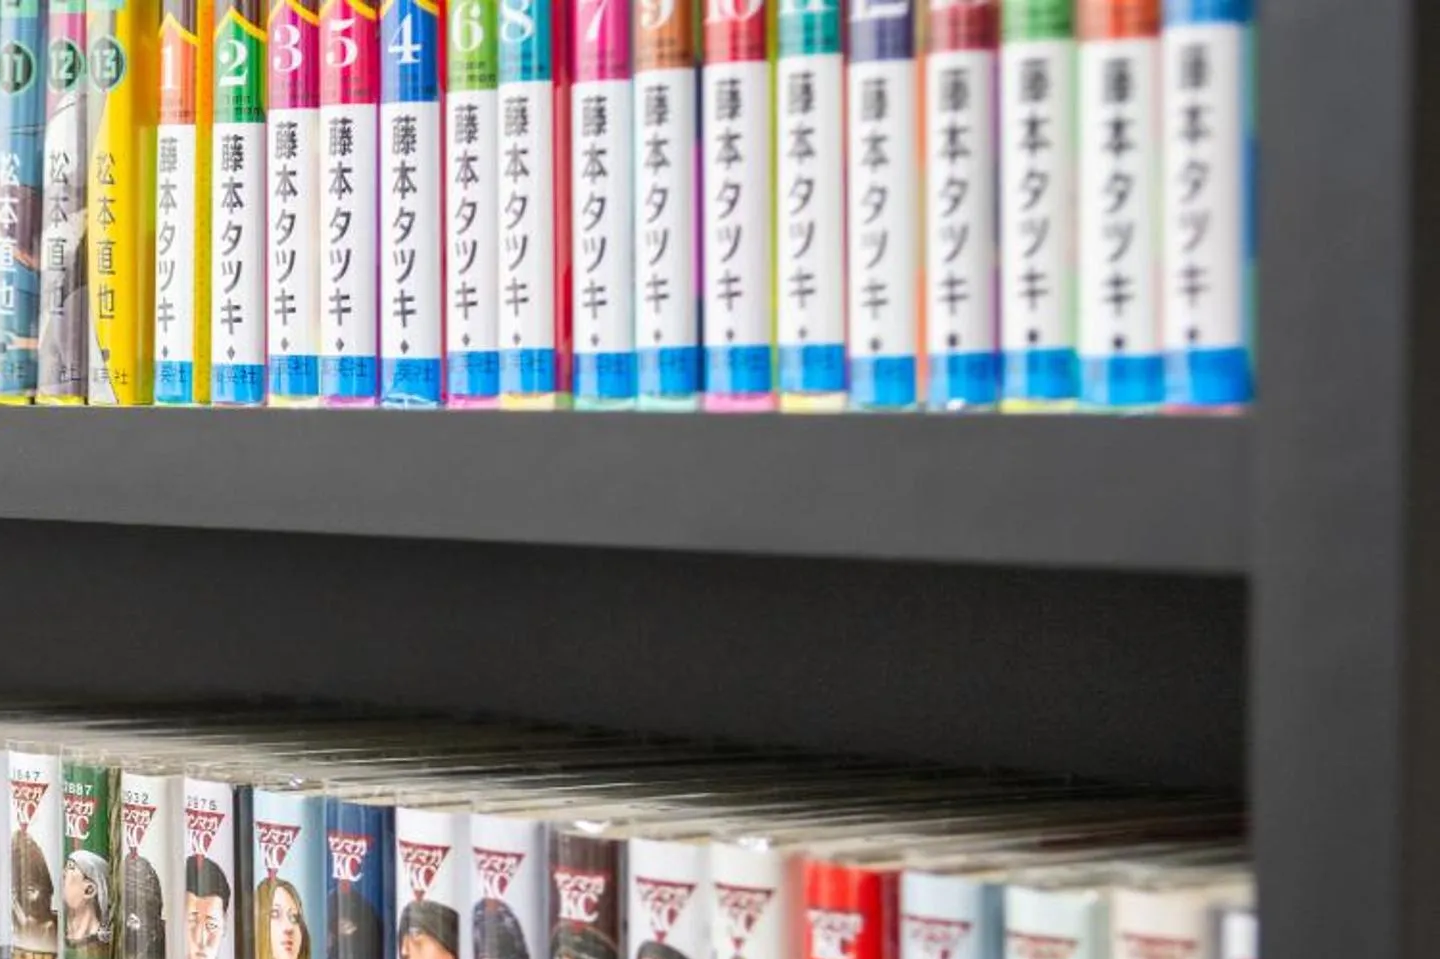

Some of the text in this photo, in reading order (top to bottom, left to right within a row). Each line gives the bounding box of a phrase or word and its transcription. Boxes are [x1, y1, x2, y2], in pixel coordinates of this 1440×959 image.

[327, 18, 356, 67] 5
[388, 14, 421, 64] 4
[455, 2, 483, 52] 6
[499, 0, 533, 41] 8
[582, 0, 616, 39] 7
[3, 54, 25, 85] 11
[49, 50, 74, 80] 12
[95, 49, 116, 80] 13
[161, 45, 178, 91] 1
[219, 40, 247, 87] 2
[274, 24, 303, 72] 3
[275, 122, 298, 326] 藤本タツキ
[329, 117, 353, 327] 藤本タツキ
[393, 116, 417, 328] 藤本タツキ
[455, 104, 479, 320] 藤本タツキ
[505, 97, 529, 316] 藤本タツキ
[583, 96, 607, 319] 藤本タツキ
[97, 153, 116, 319] 松本直也
[158, 137, 178, 333] 藤本タツキ
[221, 135, 244, 334] 藤本タツキ
[65, 814, 89, 839] KC
[260, 843, 287, 869] KC
[331, 853, 362, 881] KC
[558, 891, 600, 922] KC
